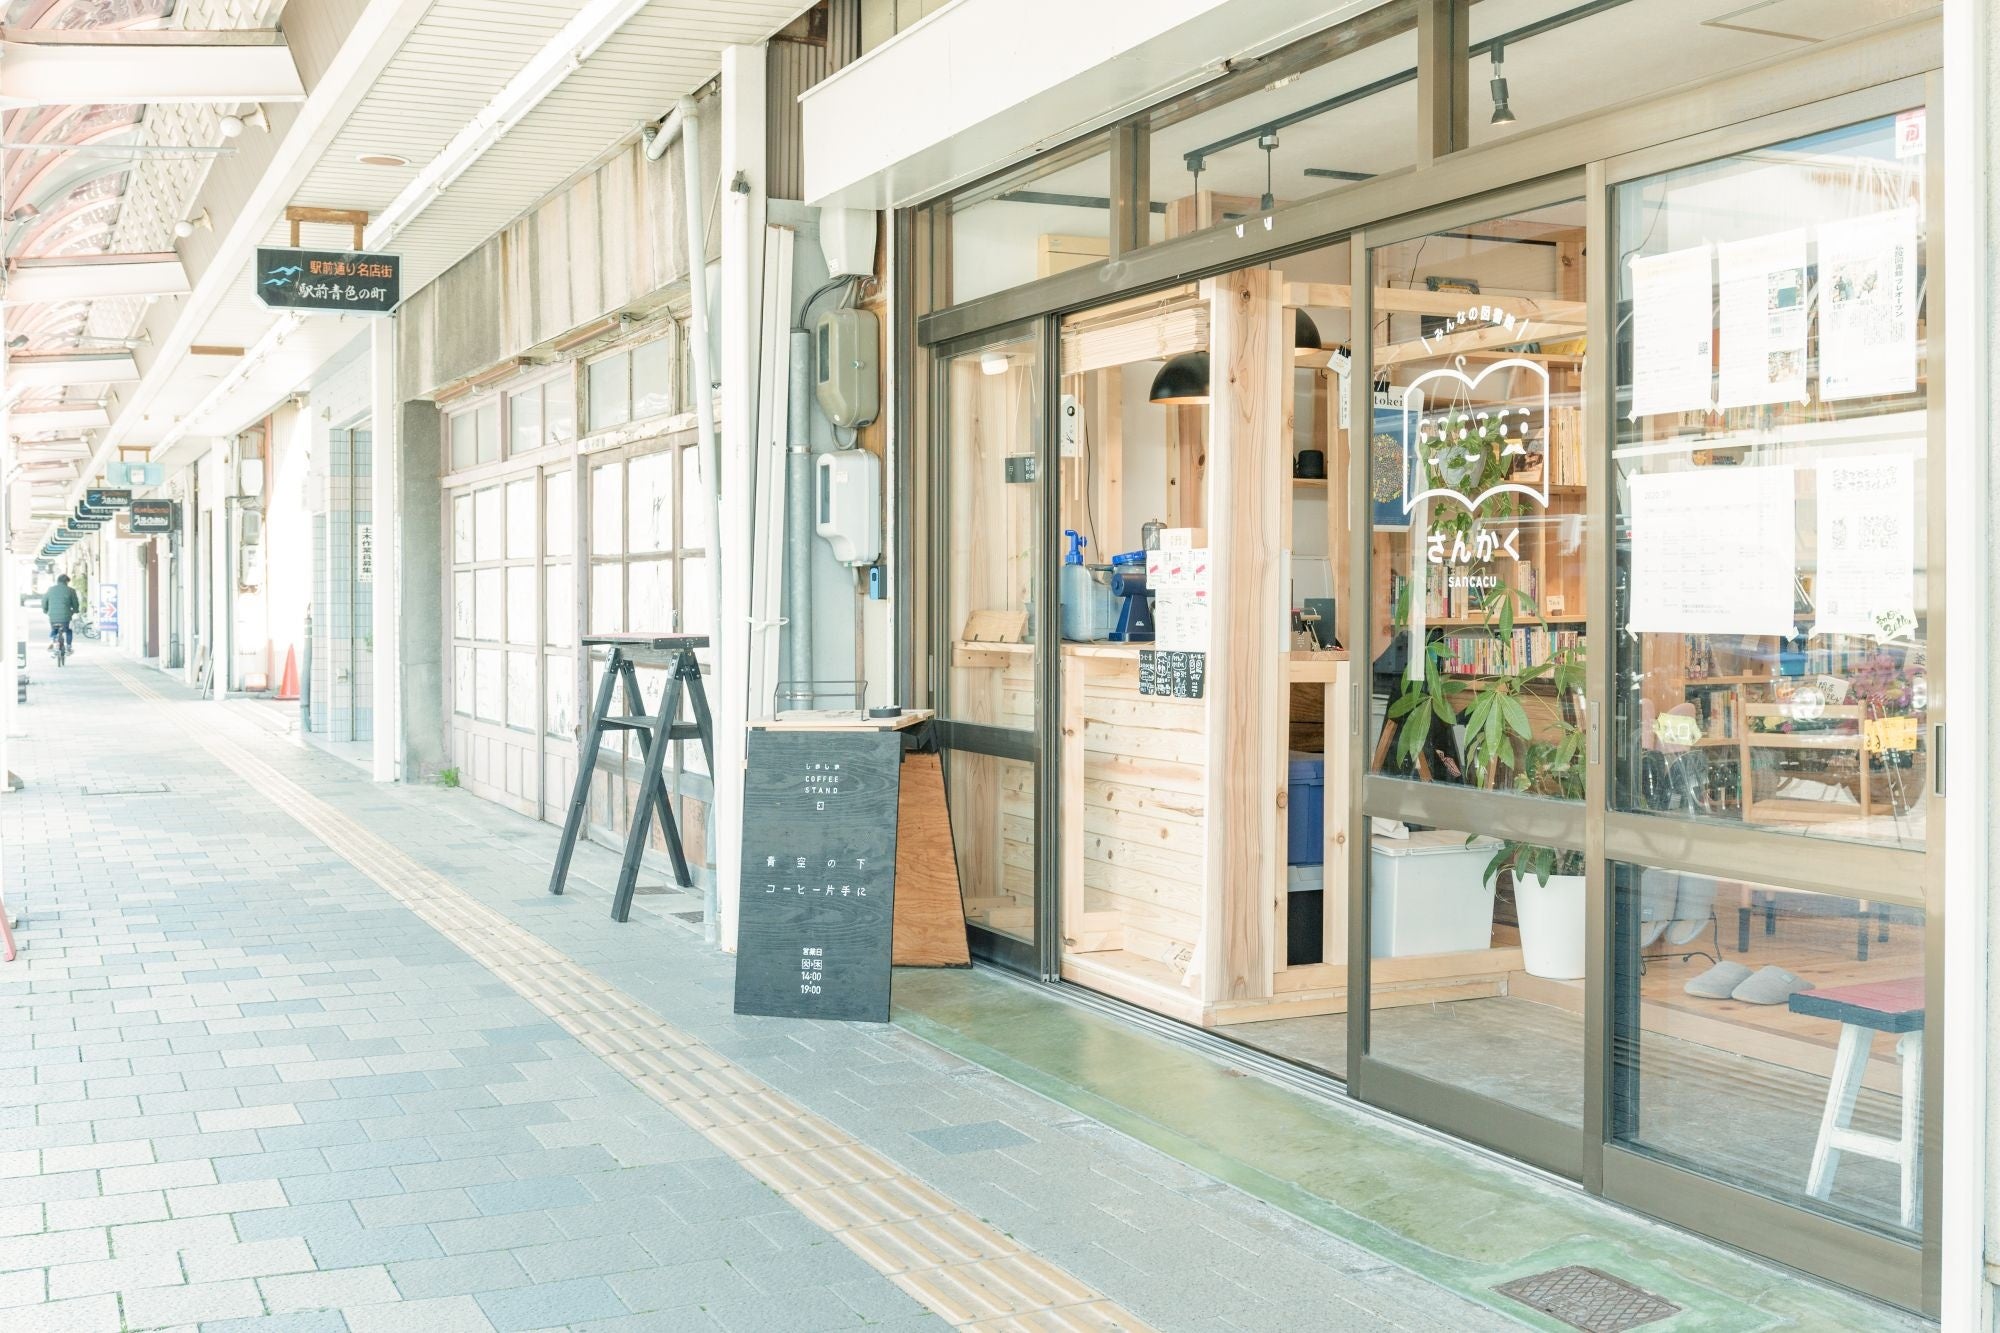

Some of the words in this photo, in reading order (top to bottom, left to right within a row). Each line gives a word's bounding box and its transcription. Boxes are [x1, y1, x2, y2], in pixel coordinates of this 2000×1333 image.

[309, 260, 393, 278] 駅前通り名店街
[1427, 527, 1520, 563] さんかく
[805, 775, 839, 783] COFFEE
[804, 786, 838, 794] STAND
[766, 856, 866, 870] 青空の下
[766, 884, 867, 897] コーヒー片手に
[802, 947, 823, 956] 営業日
[801, 971, 822, 981] 14:00
[800, 984, 821, 995] 19:00
